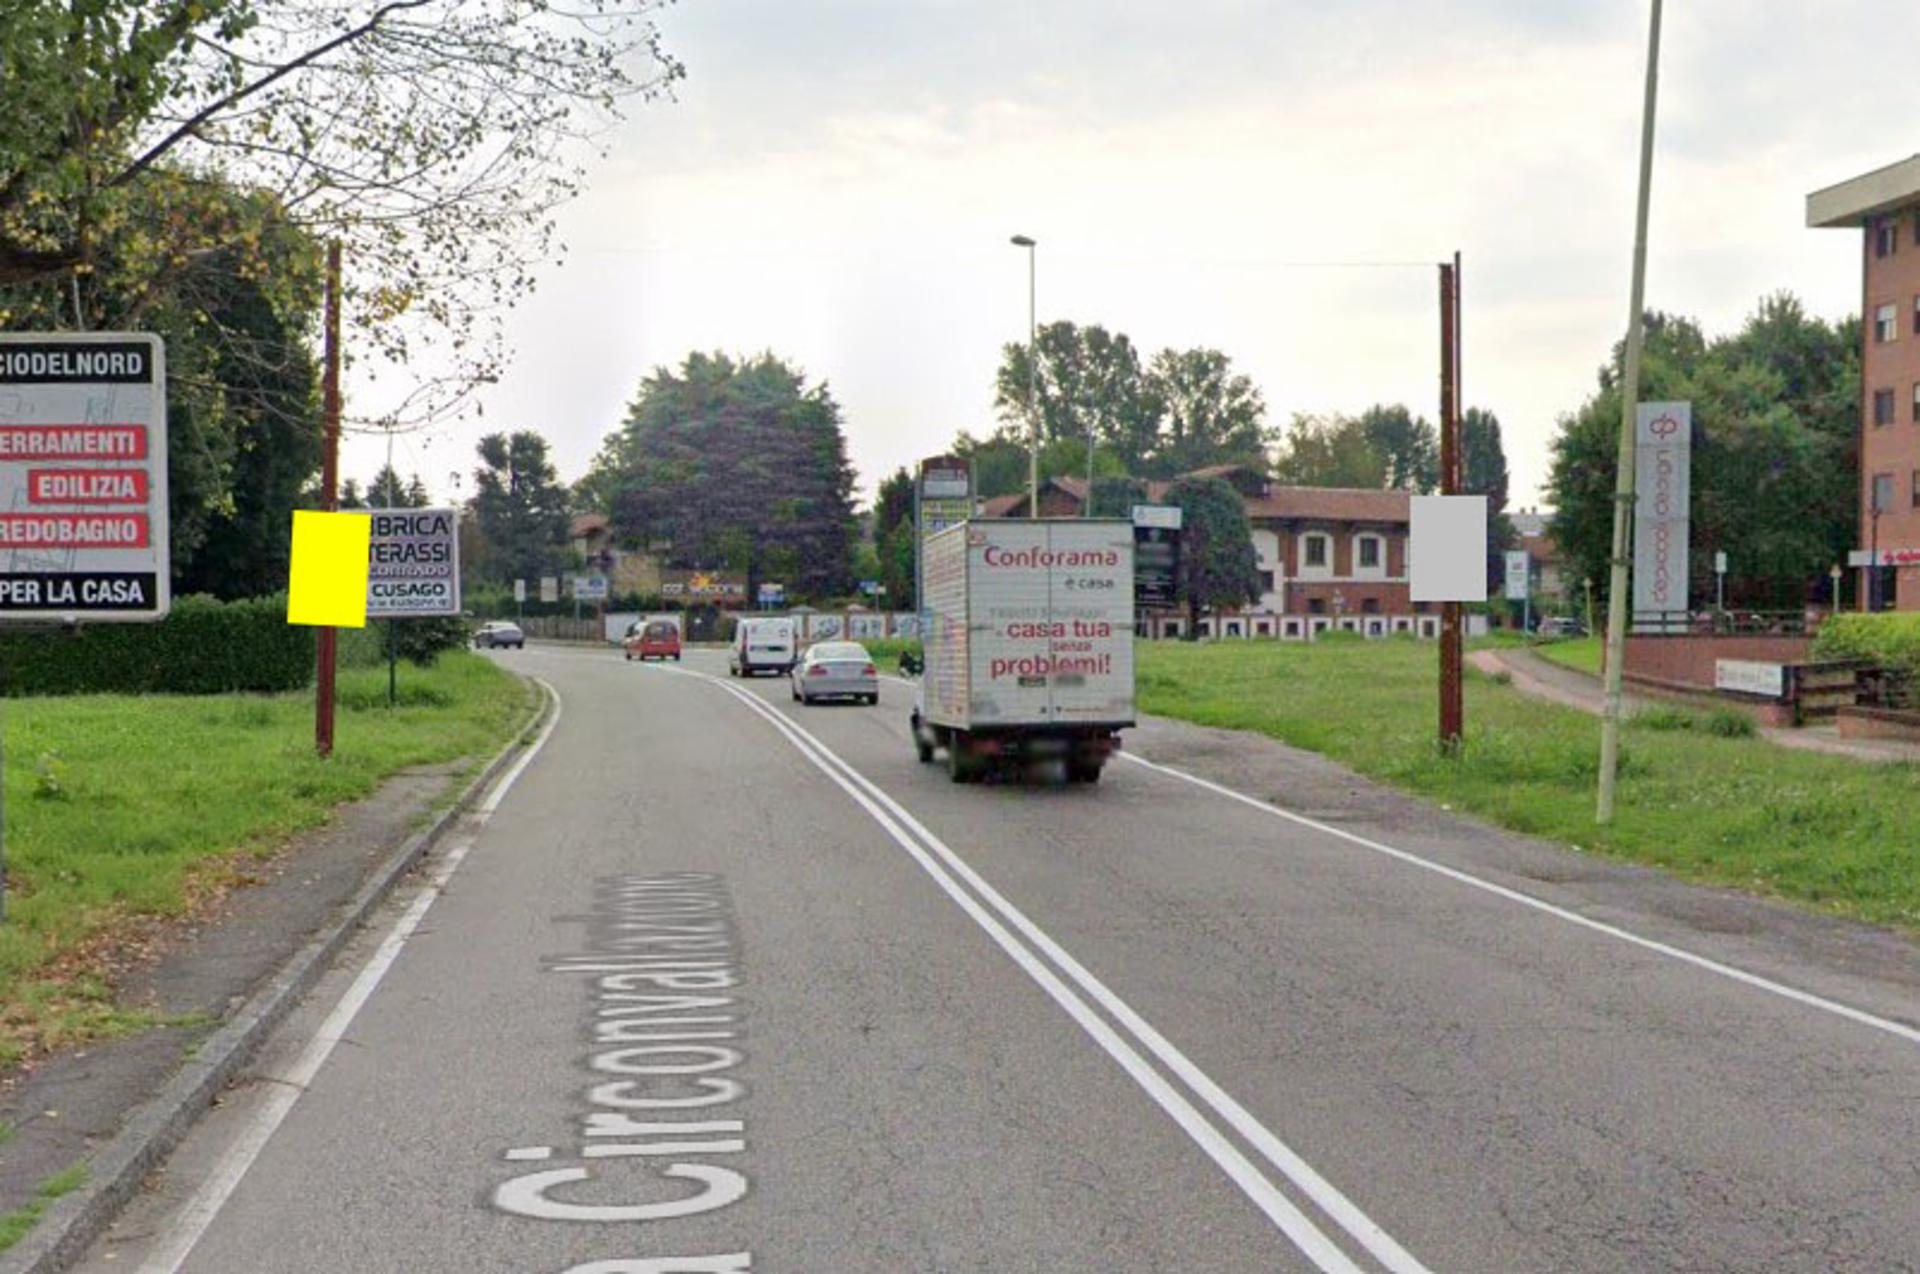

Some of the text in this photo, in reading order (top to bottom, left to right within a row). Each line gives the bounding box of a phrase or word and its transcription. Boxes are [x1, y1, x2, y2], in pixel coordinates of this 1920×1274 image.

[38, 475, 137, 497] EDILIZIA
[984, 546, 1119, 568] Conforama
[0, 580, 144, 603] PER LA CASA
[372, 583, 446, 597] CUSAGO
[1078, 579, 1114, 589] casa
[1007, 621, 1066, 639] casa
[1073, 618, 1111, 639] tua
[991, 653, 1111, 680] problemi!
